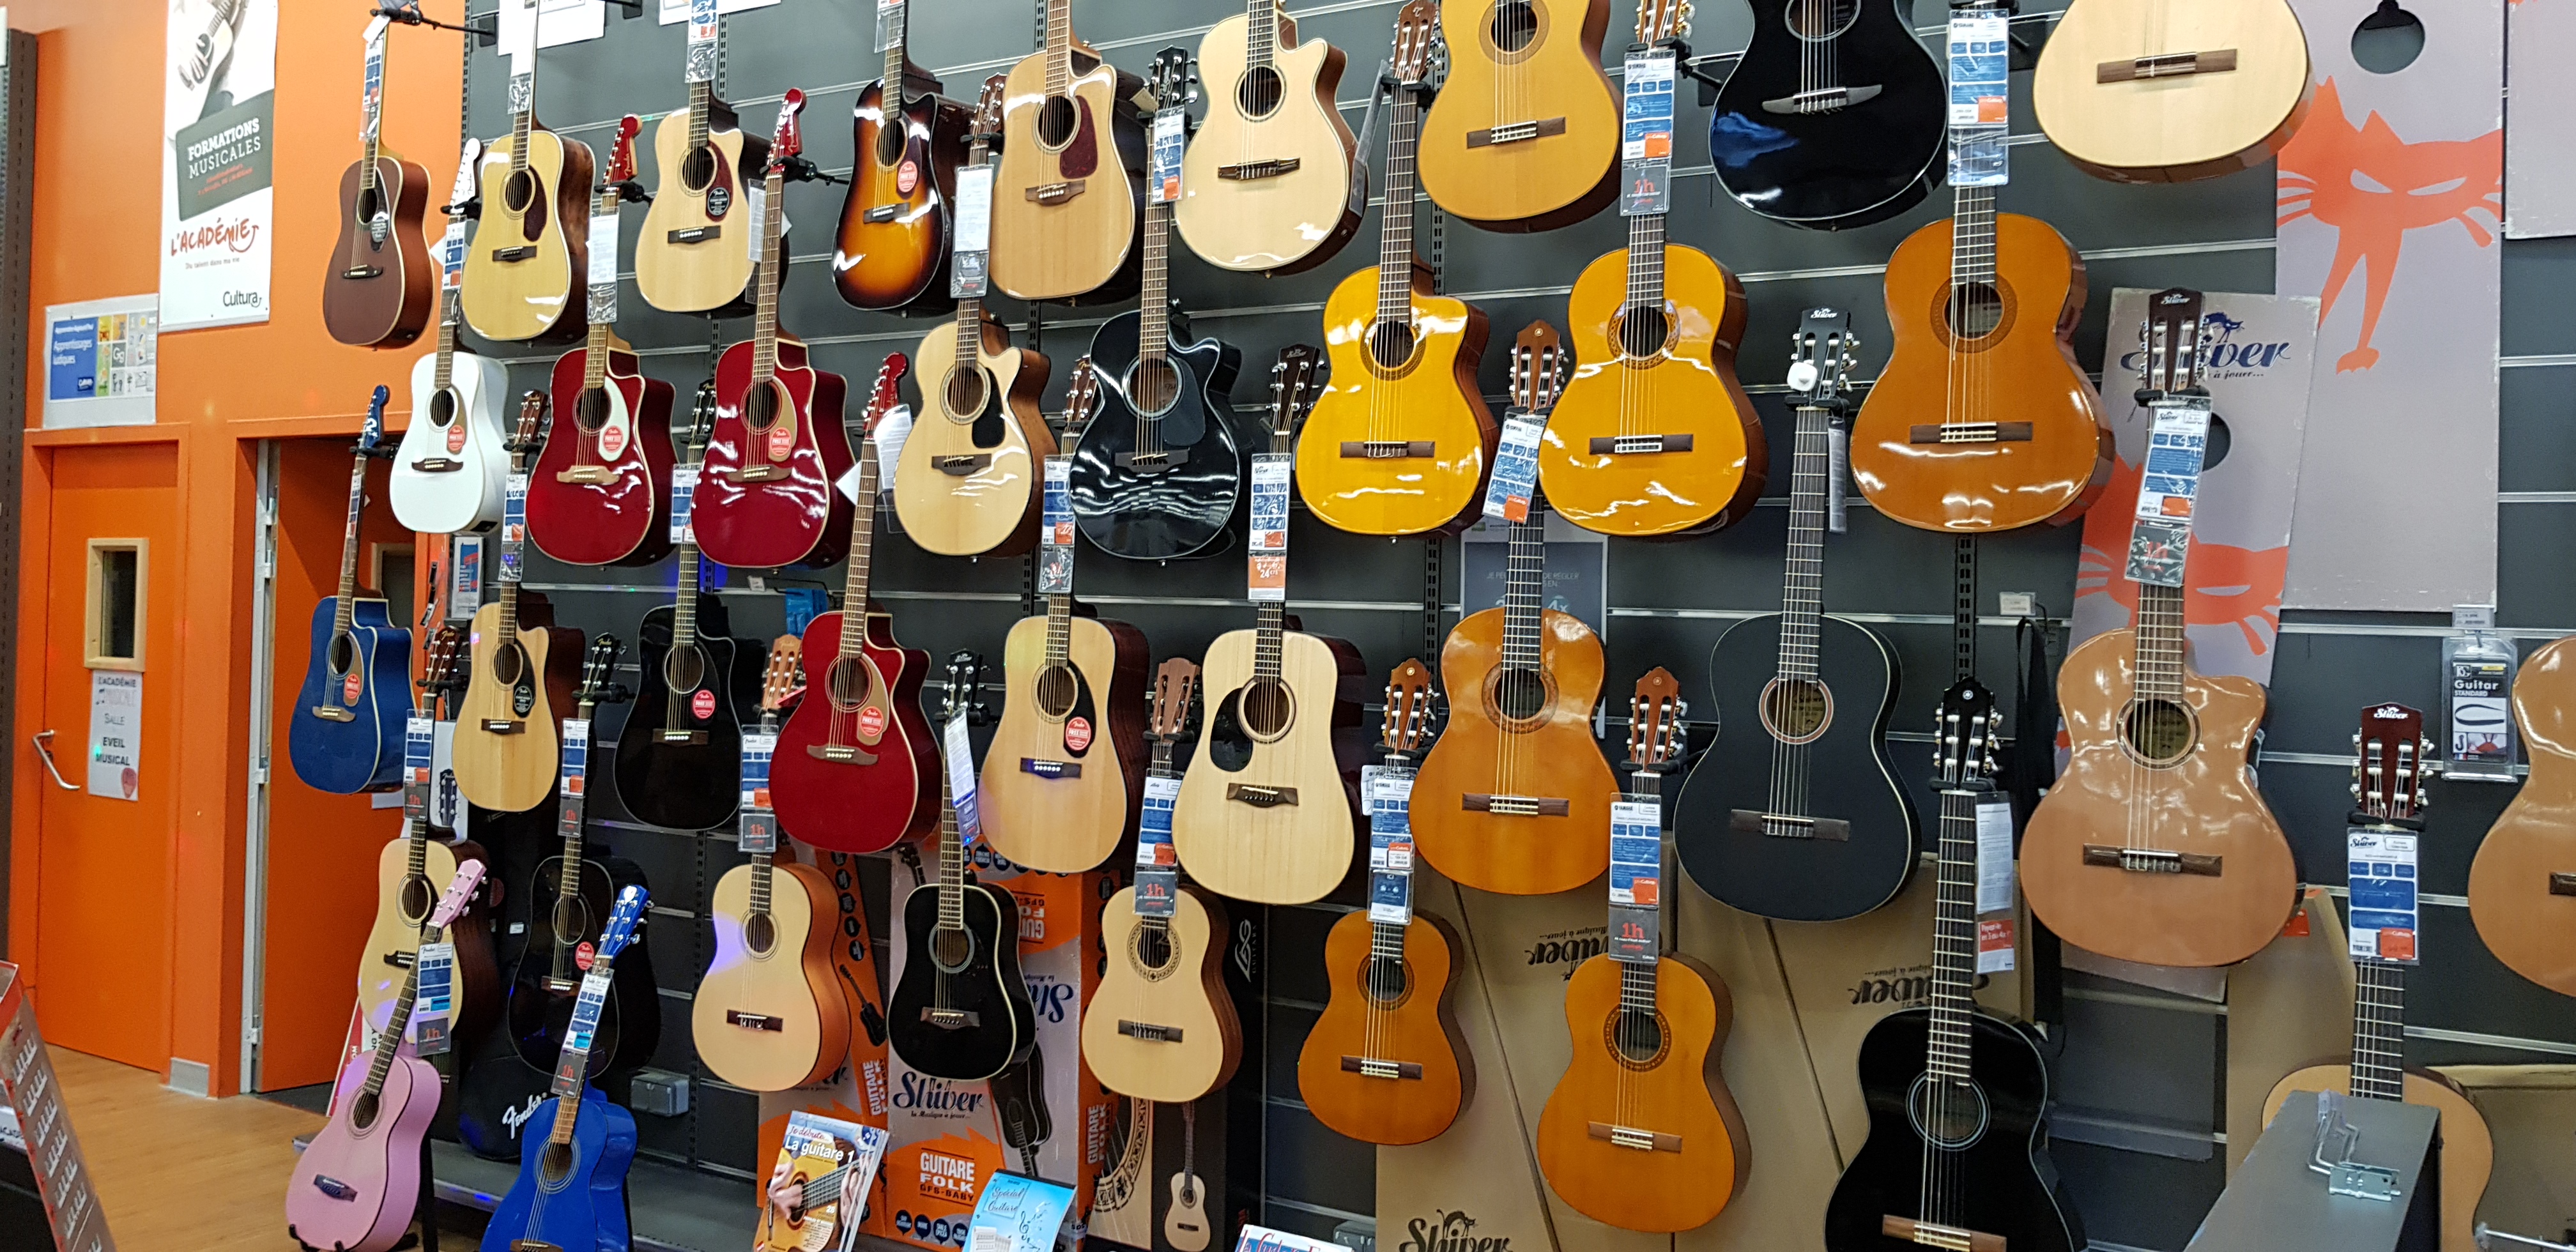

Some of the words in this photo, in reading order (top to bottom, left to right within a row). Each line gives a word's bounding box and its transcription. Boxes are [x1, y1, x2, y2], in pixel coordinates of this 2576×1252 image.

[188, 118, 260, 161] FORMATIONS
[189, 136, 261, 179] MUSICALES
[1634, 179, 1655, 194] 1h
[223, 290, 262, 308] Cultura
[2454, 680, 2499, 690] Guitar
[103, 737, 125, 748] EVEIL
[96, 753, 130, 766] MUSICAL
[1146, 883, 1165, 897] 1h
[1622, 922, 1644, 940] 1h
[862, 1060, 882, 1117] GUITARE
[893, 1071, 983, 1112] Shiver
[502, 1094, 544, 1140] Fender
[1087, 1104, 1100, 1164] GUITARE
[785, 1137, 799, 1150] La
[801, 1140, 844, 1161] guitare
[848, 1150, 855, 1163] 1
[920, 1152, 975, 1182] GUITARE
[920, 1172, 974, 1194] FOLK
[920, 1184, 974, 1202] GFS-BABY
[992, 1187, 1025, 1200] Spécial
[988, 1200, 1019, 1212] Guitare
[1399, 1218, 1514, 1252] Shiver
